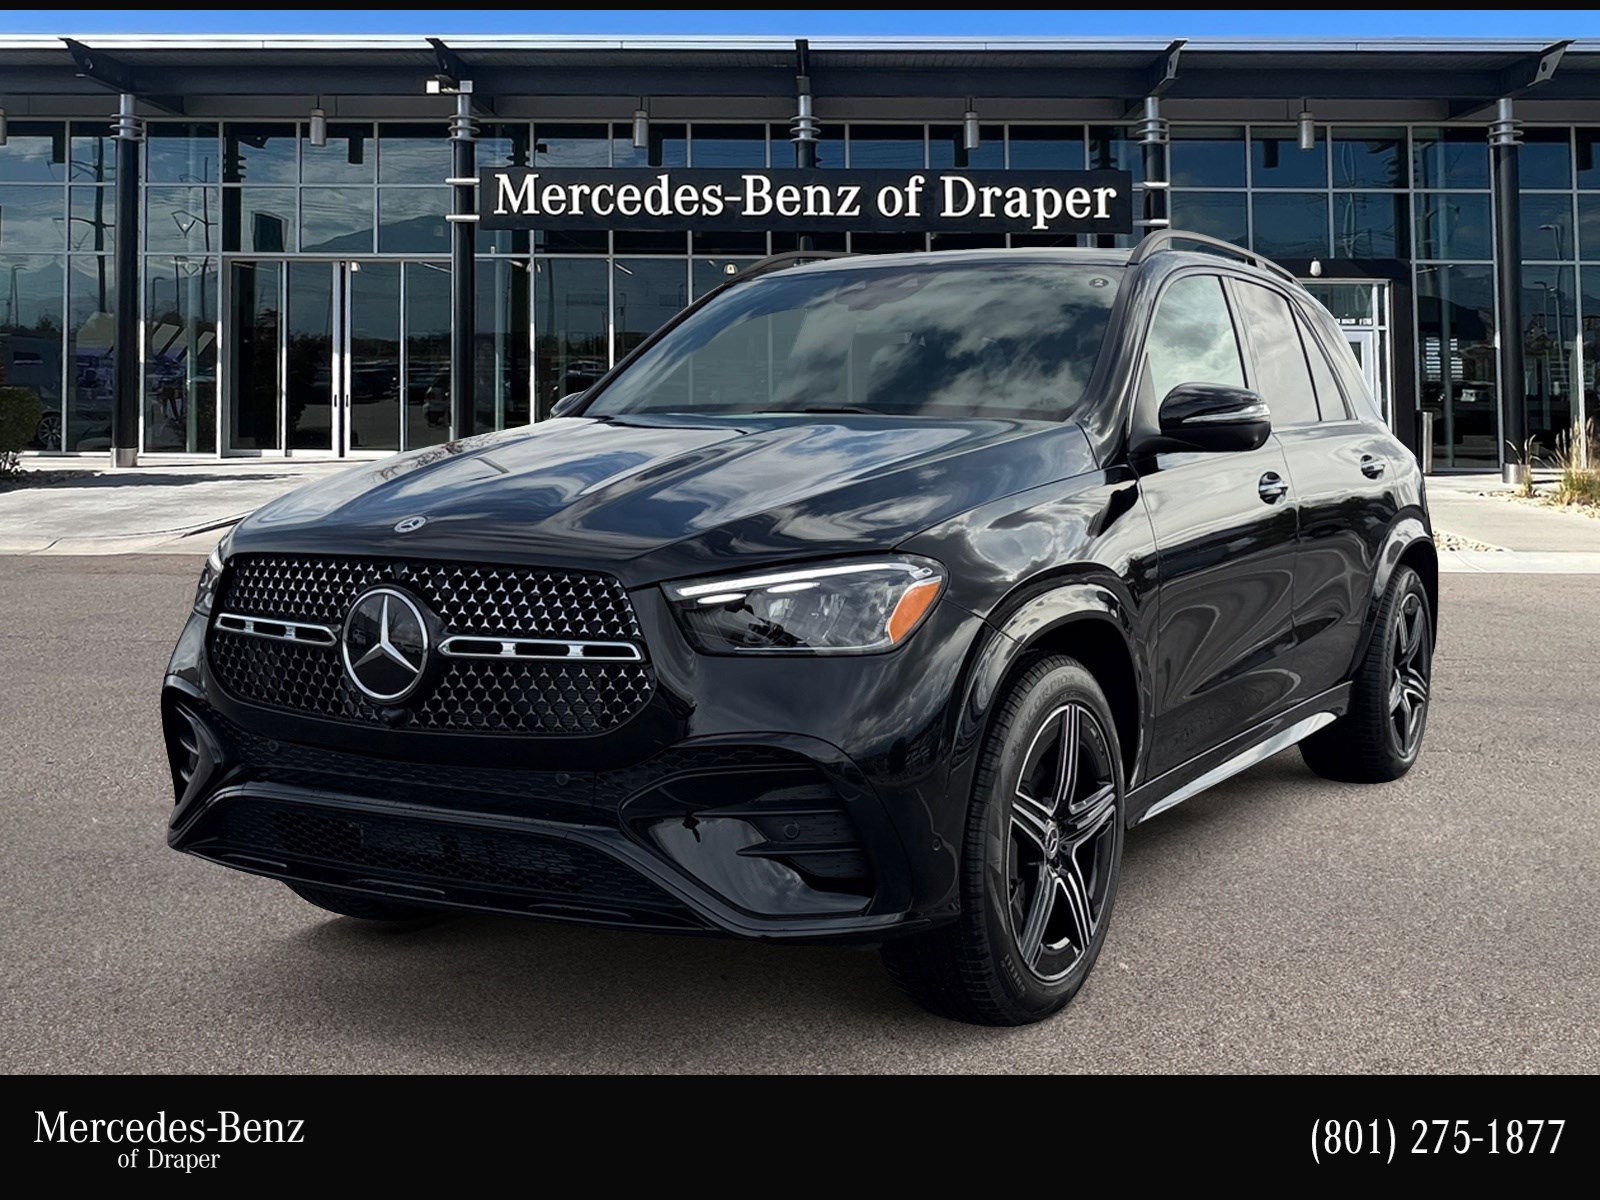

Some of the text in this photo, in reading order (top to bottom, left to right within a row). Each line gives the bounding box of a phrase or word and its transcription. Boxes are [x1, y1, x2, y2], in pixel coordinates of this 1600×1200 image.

[493, 173, 1117, 230] Mercedes-Benz of Draper
